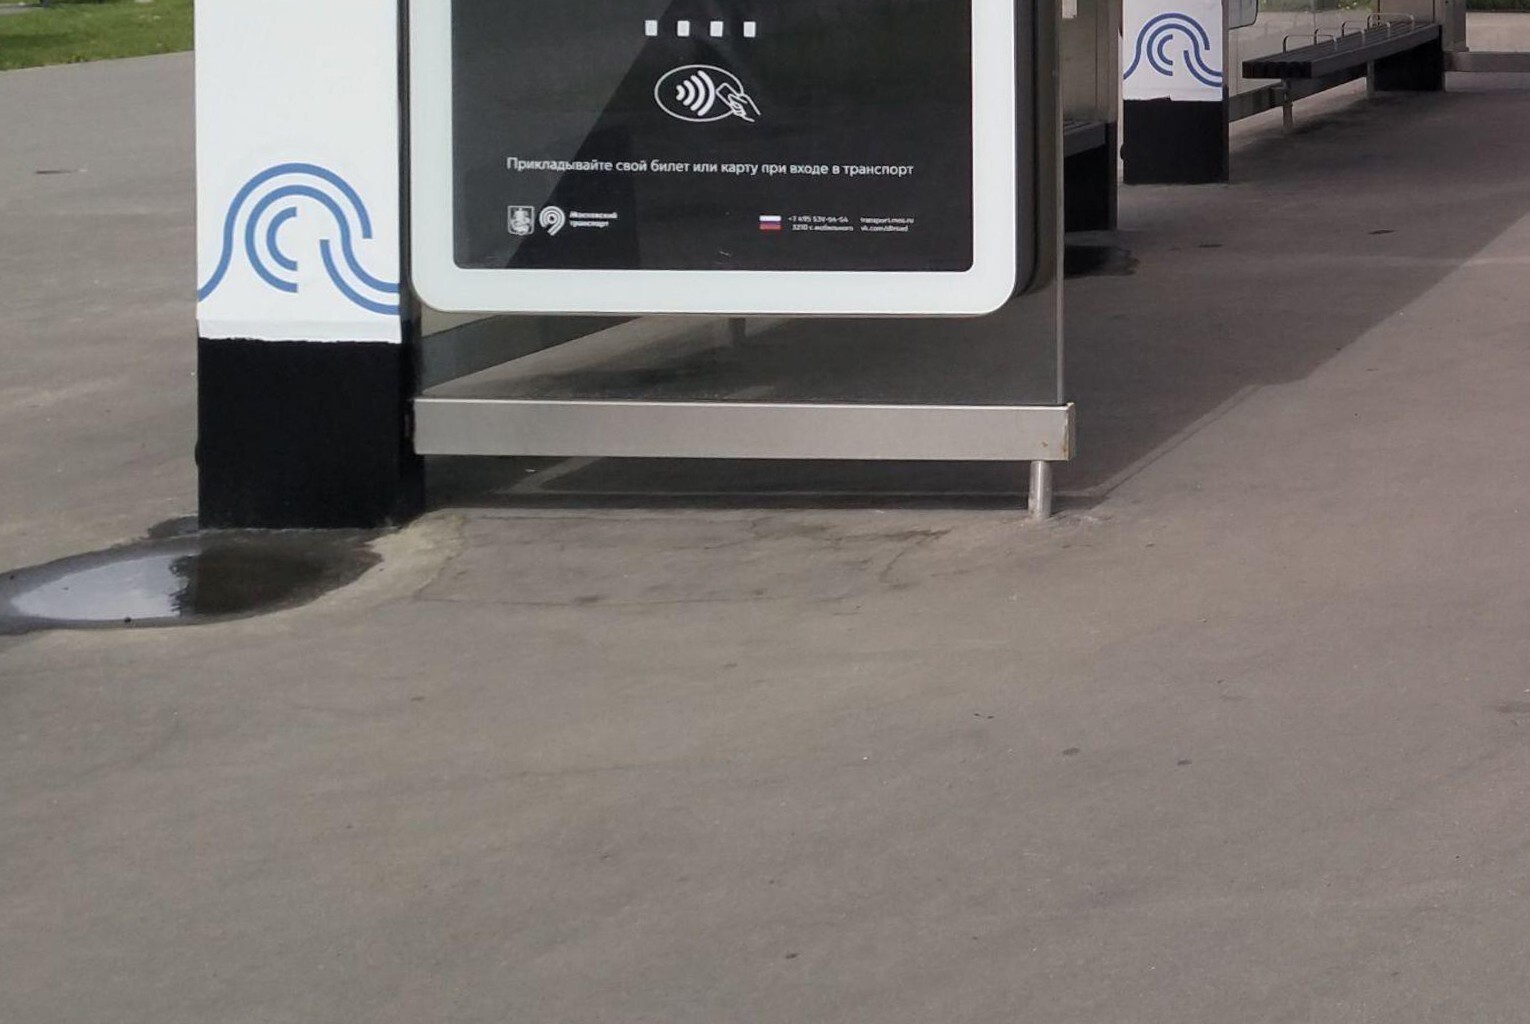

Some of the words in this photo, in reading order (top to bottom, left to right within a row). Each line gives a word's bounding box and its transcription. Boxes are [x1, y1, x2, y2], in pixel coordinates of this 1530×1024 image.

[506, 156, 613, 173] Прикладывайте
[615, 159, 648, 173] свой
[650, 158, 691, 173] билет
[692, 162, 718, 173] или
[720, 163, 759, 176] карту
[761, 163, 787, 175] при
[789, 164, 830, 176] входе
[831, 164, 841, 175] в
[842, 164, 914, 178] транспорт
